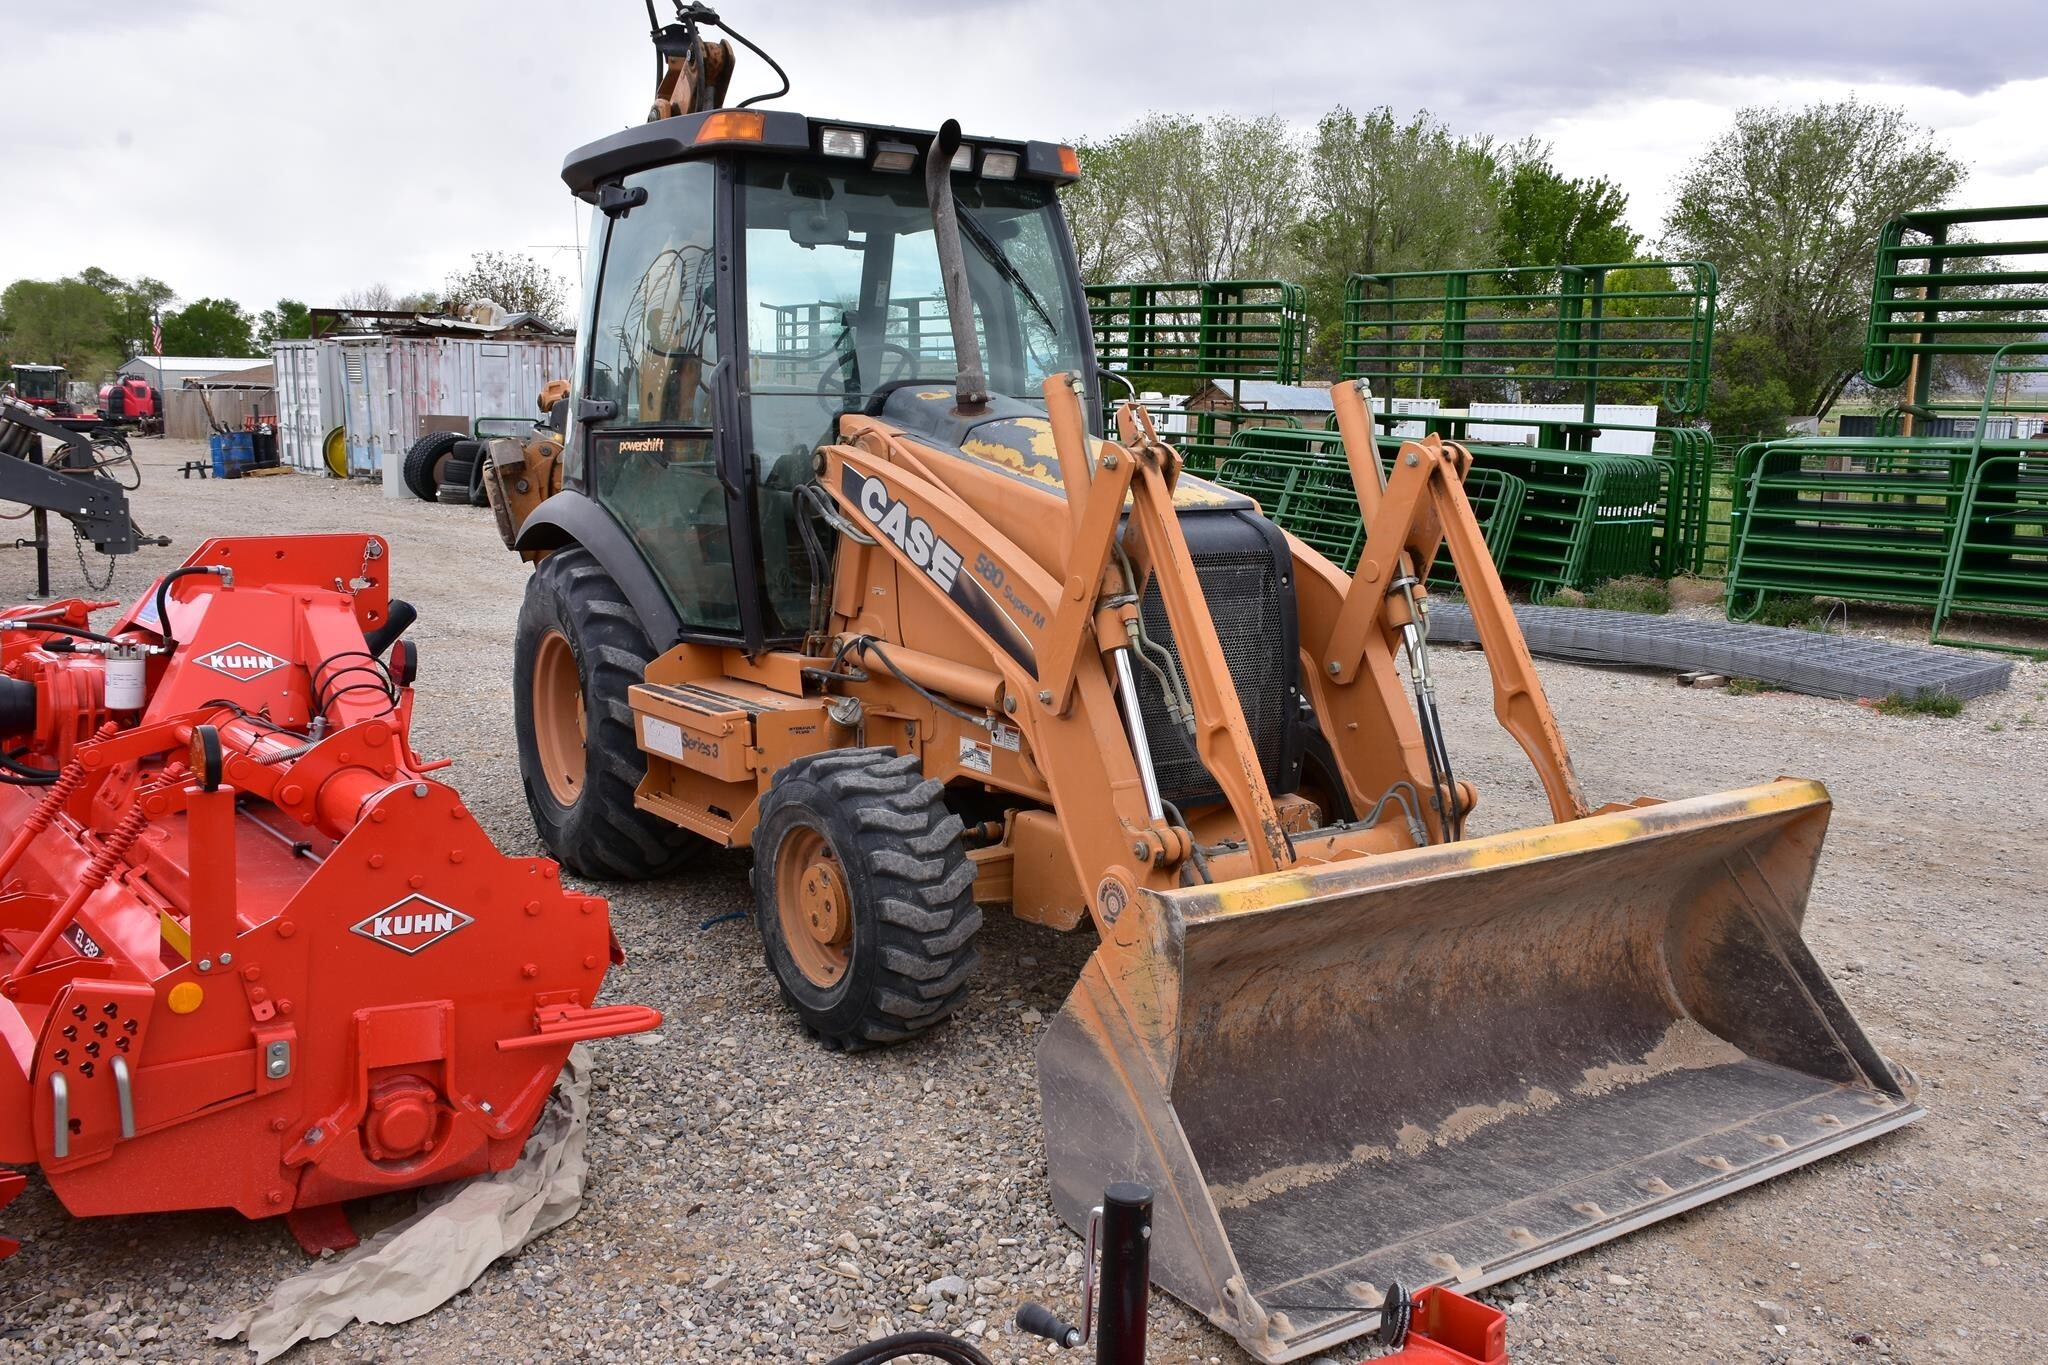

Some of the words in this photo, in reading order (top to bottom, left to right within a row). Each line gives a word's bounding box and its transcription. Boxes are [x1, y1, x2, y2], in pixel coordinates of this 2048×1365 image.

[618, 438, 665, 455] powershift
[860, 476, 963, 594] CASE
[974, 552, 1005, 590] 580
[1003, 584, 1033, 618] Super
[1032, 611, 1046, 630] M
[210, 654, 275, 670] KUHN
[681, 731, 711, 757] Series
[711, 742, 719, 759] 3
[373, 912, 453, 937] KUHN
